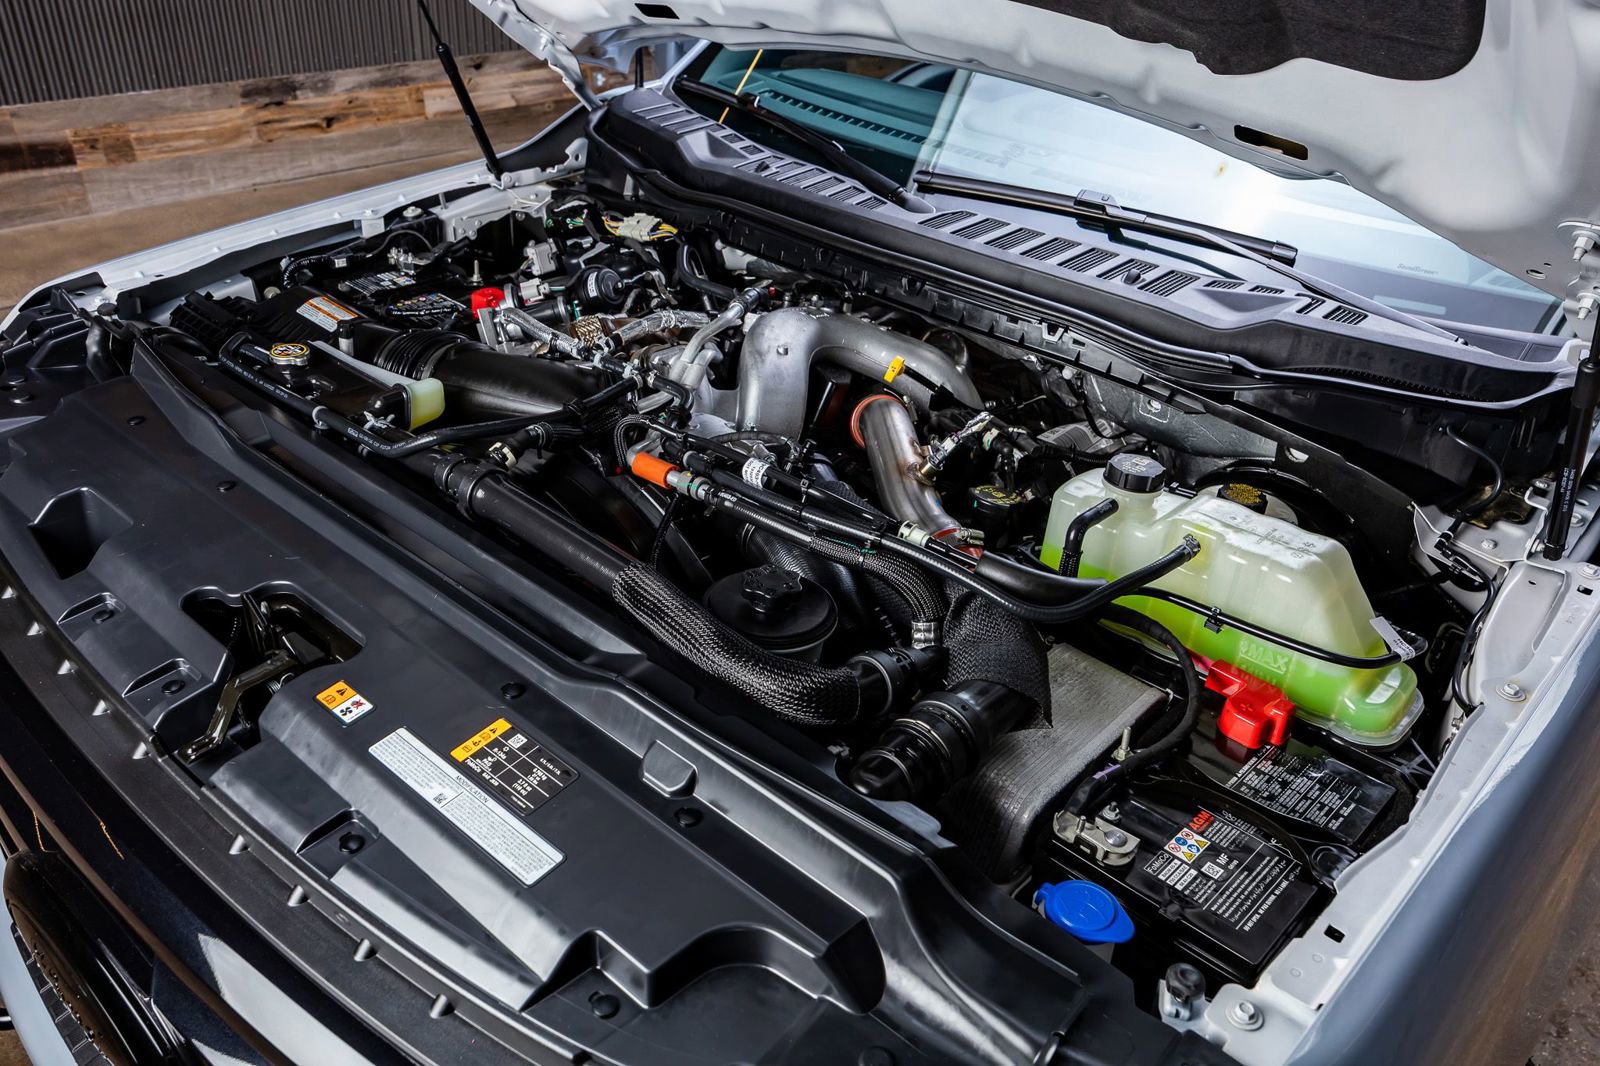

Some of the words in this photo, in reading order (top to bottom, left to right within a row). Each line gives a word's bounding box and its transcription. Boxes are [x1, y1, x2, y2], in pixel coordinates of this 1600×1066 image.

[1247, 642, 1289, 672] MAX
[455, 776, 490, 803] MODIFICATION
[1189, 811, 1210, 830] AGM
[1146, 852, 1170, 874] FoMoCo
[1216, 853, 1229, 865] MF
